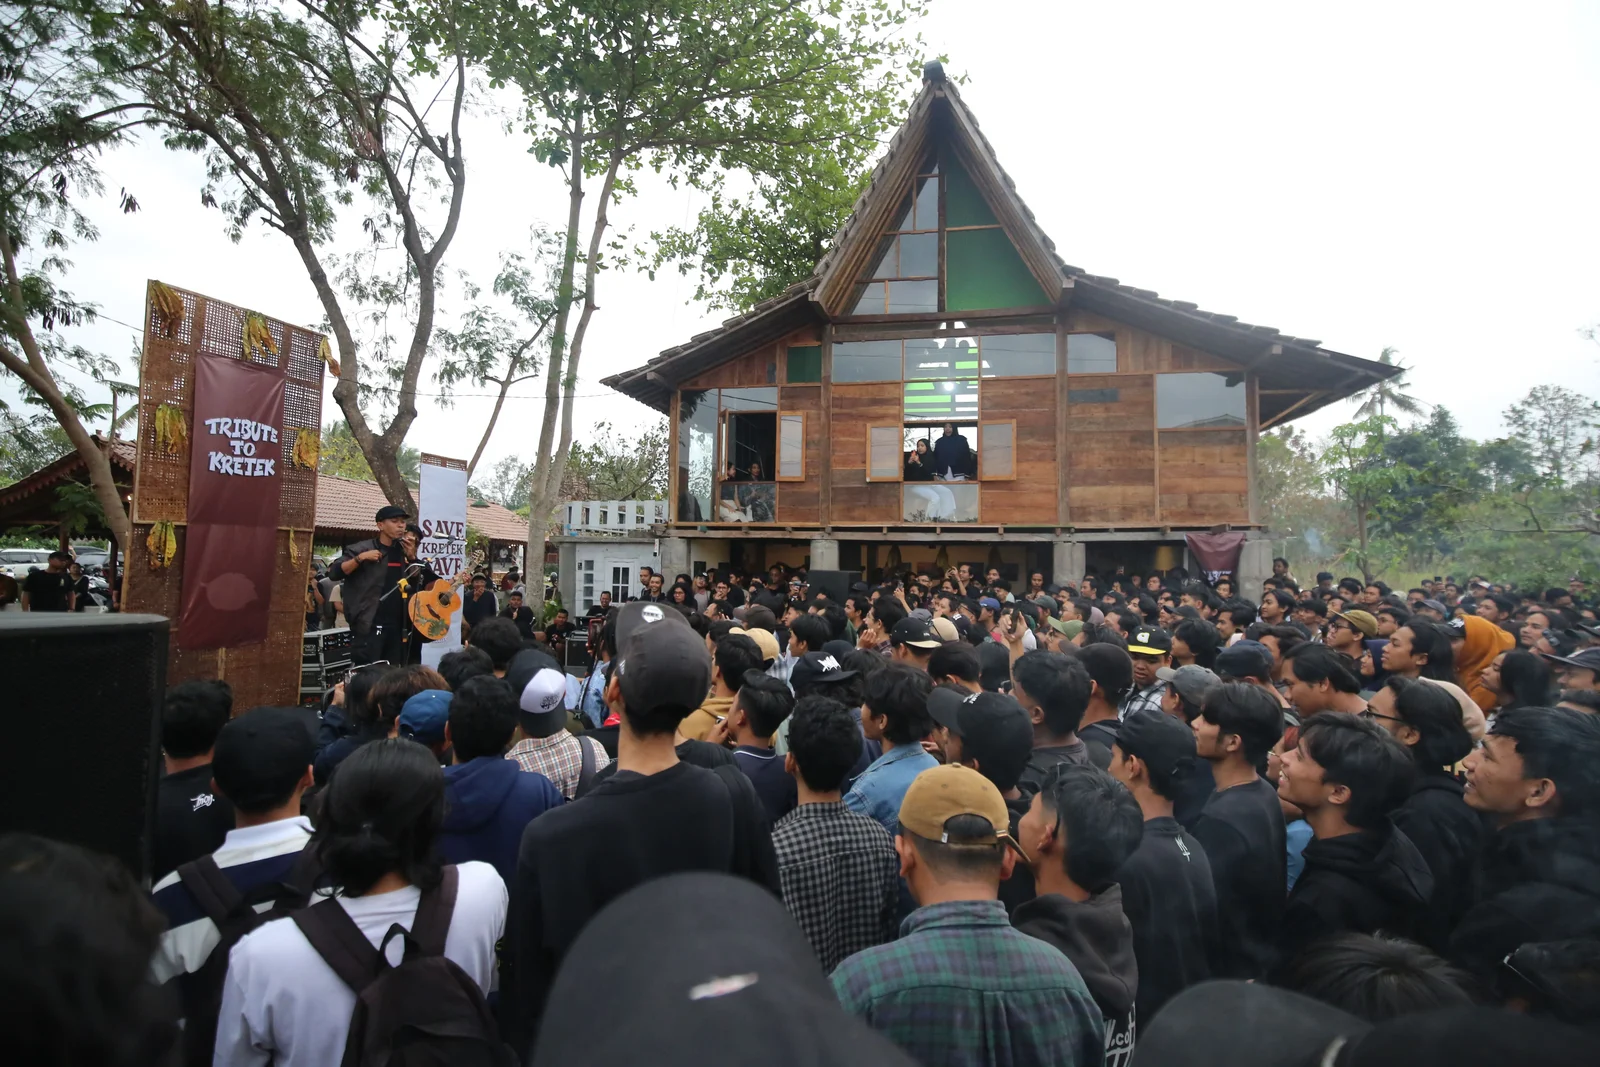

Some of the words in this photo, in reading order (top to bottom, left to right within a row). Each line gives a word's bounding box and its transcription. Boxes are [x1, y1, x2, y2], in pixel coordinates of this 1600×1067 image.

[204, 417, 279, 444] TRIBUTE
[229, 440, 256, 457] TO
[207, 451, 276, 477] KRETEK
[422, 519, 464, 538] SAVE
[421, 542, 463, 555] KRETEK
